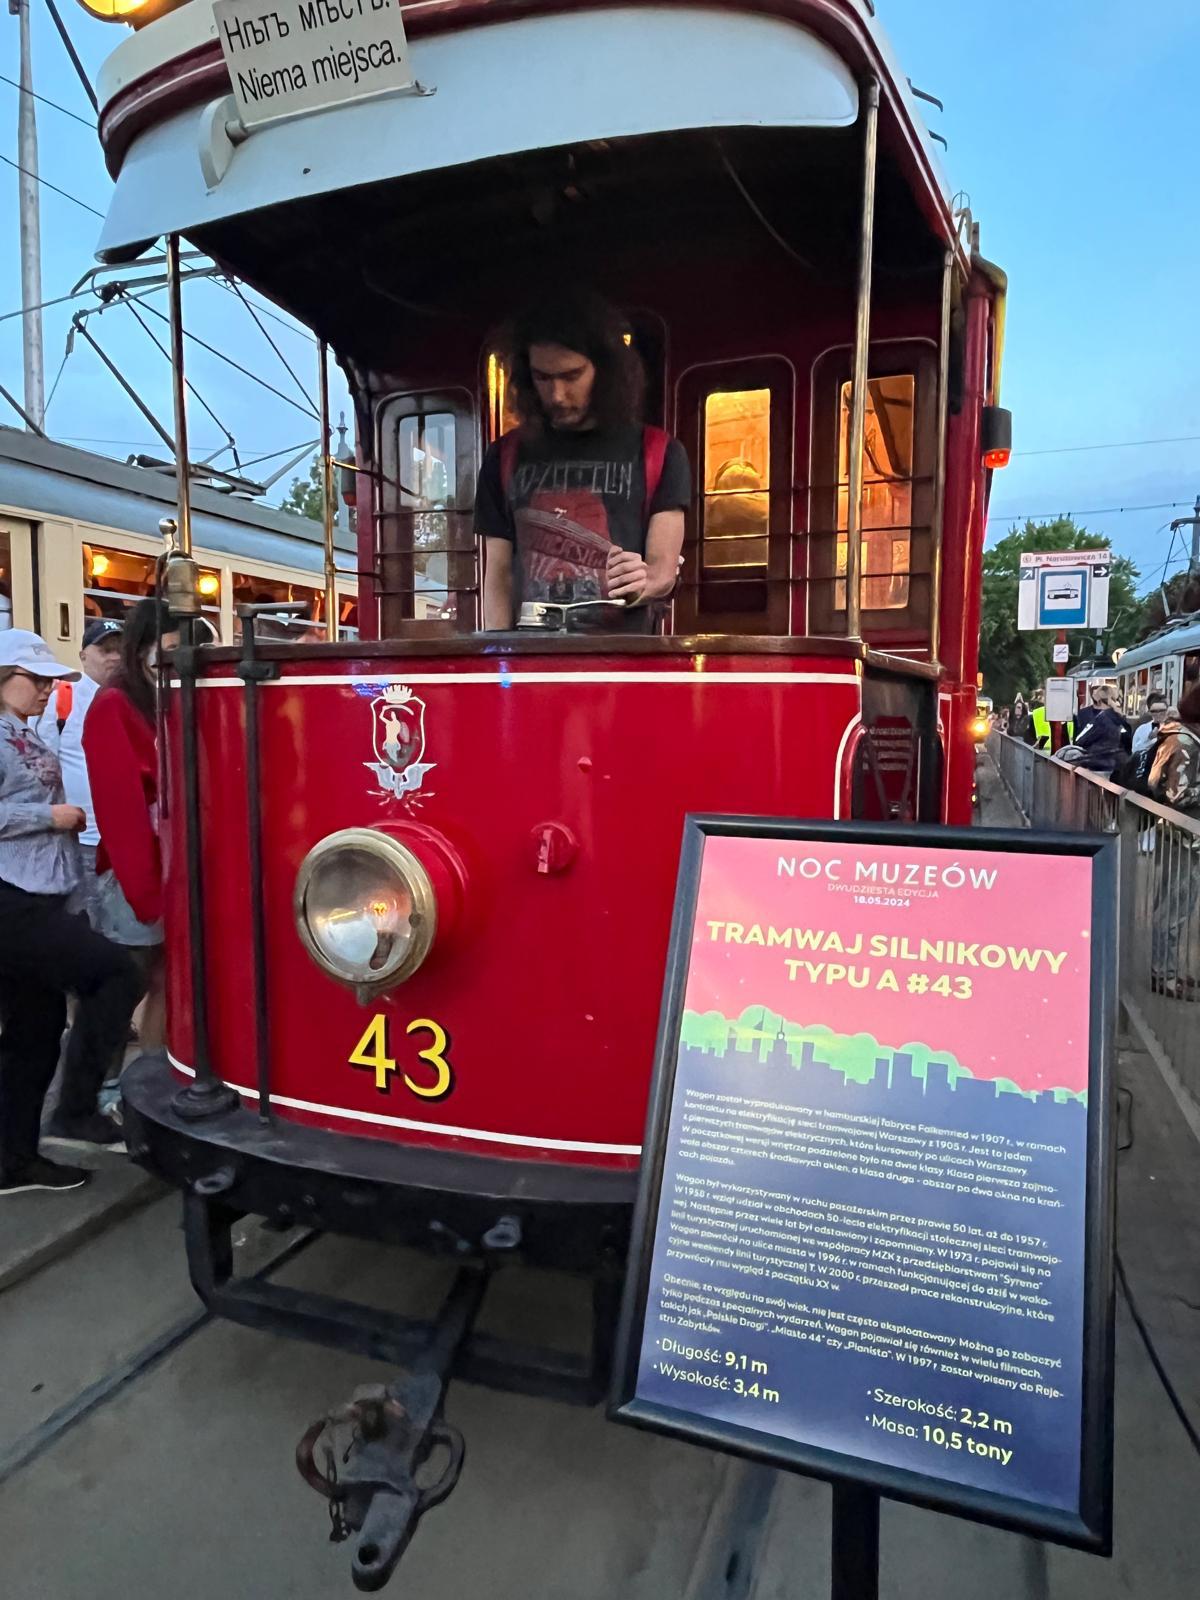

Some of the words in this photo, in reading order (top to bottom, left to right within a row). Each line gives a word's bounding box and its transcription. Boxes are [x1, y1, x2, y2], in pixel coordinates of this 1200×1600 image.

[237, 64, 307, 104] Niema
[311, 39, 402, 83] miejsca.
[777, 857, 842, 880] NOC
[855, 862, 997, 890] MUZEÓW
[827, 883, 895, 895] DWUDZIESTA
[897, 888, 939, 898] EDYCJA
[854, 895, 910, 907] 18.05.2024
[706, 920, 863, 955] TRAMWAJ
[869, 934, 1068, 974] SILNIKOWY
[783, 959, 870, 989] TYPU
[876, 969, 900, 992] A
[907, 973, 973, 1000] #43
[347, 1013, 454, 1099] 43
[662, 1338, 722, 1363] Długość:
[725, 1351, 747, 1370] 9,1
[751, 1360, 768, 1374] m
[660, 1362, 730, 1391] Wysokość:
[733, 1379, 759, 1398] 3,4
[763, 1388, 779, 1403] m
[874, 1388, 957, 1421] Szerokość:
[960, 1408, 989, 1429] 2,2
[994, 1419, 1012, 1435] m
[872, 1414, 918, 1438] Masa:
[923, 1425, 962, 1450] 10,5
[966, 1437, 1013, 1466] tony
